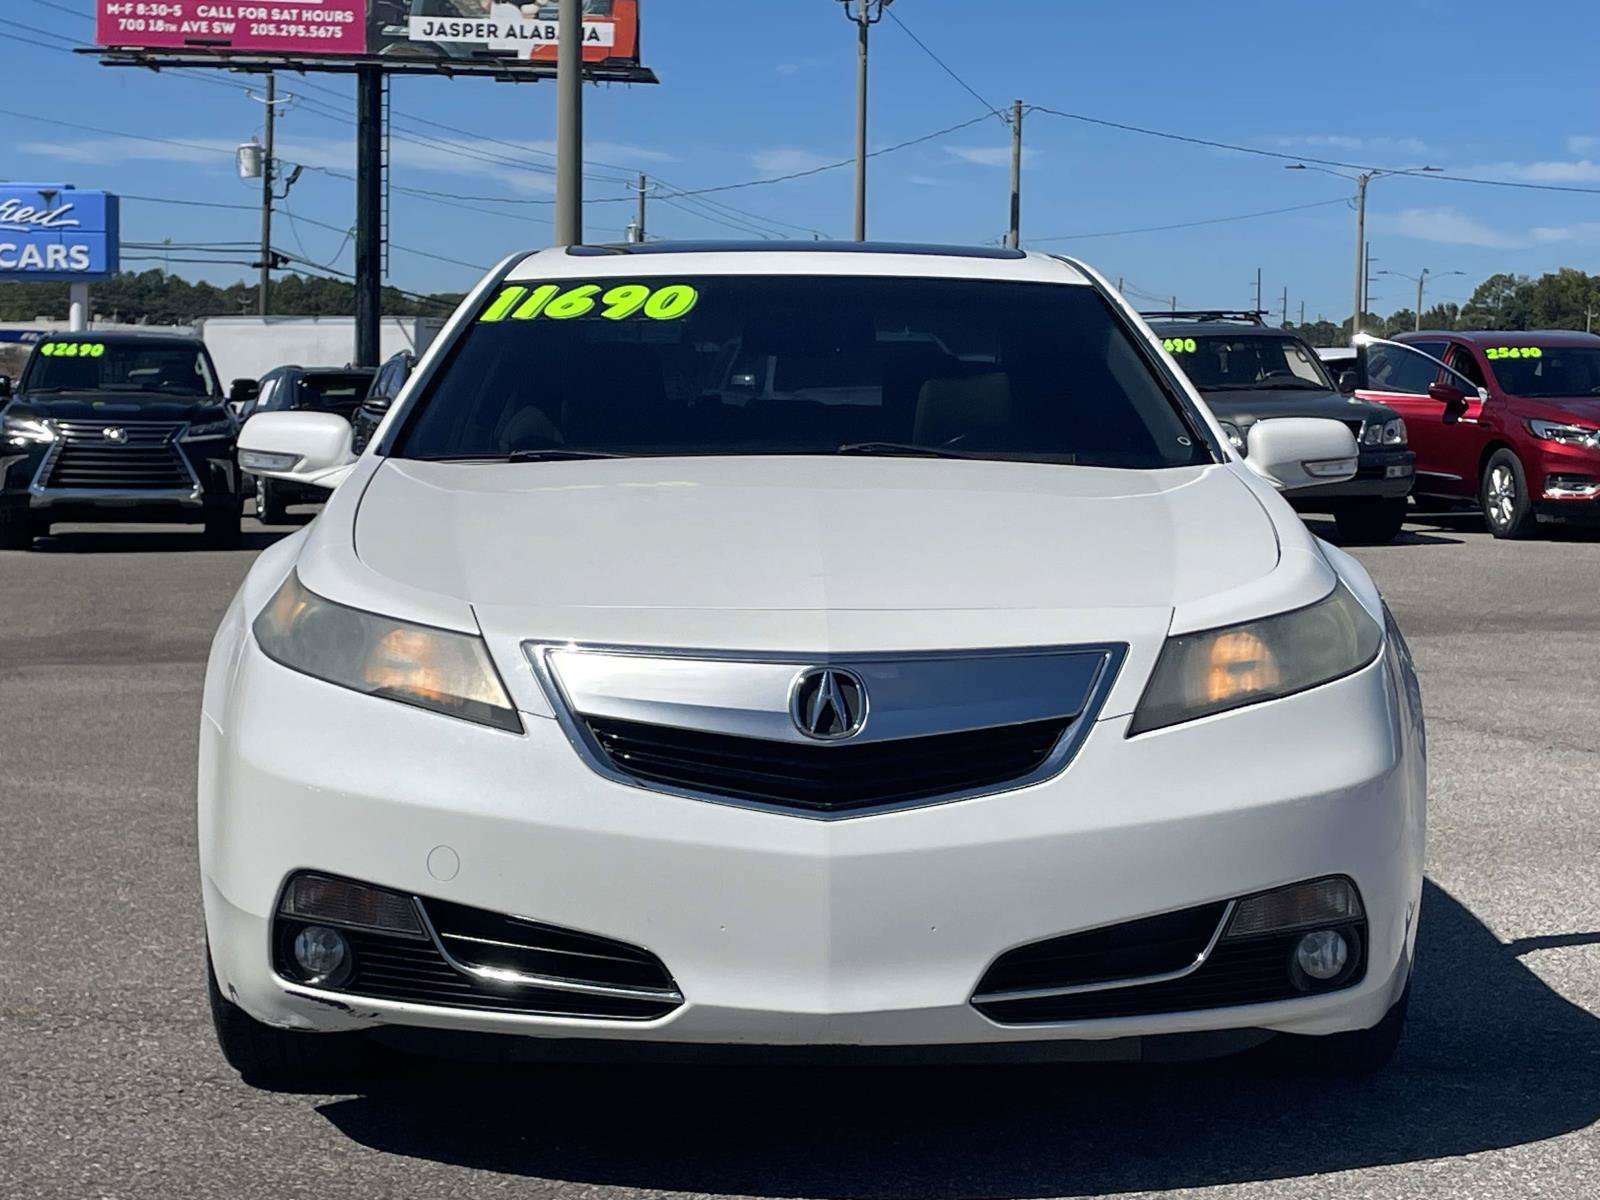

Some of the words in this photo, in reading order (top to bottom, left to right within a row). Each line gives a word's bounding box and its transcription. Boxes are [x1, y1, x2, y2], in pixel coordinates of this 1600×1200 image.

[106, 3, 133, 15] M-F
[136, 3, 182, 17] 8:30-5
[196, 5, 235, 18] CALL
[237, 7, 268, 20] FOR
[271, 8, 299, 21] SAT
[301, 10, 354, 23] HOURS
[118, 19, 145, 31] 700
[180, 21, 209, 33] AVE
[212, 22, 236, 34] SW
[250, 23, 343, 38] 205.295.5675
[422, 21, 499, 38] JASPER
[505, 24, 600, 41] ALABA
[0, 243, 90, 271] CARS
[479, 284, 698, 321] 11690
[41, 342, 104, 357] 42690
[1160, 338, 1197, 352] 690
[1486, 347, 1542, 359] 25690
